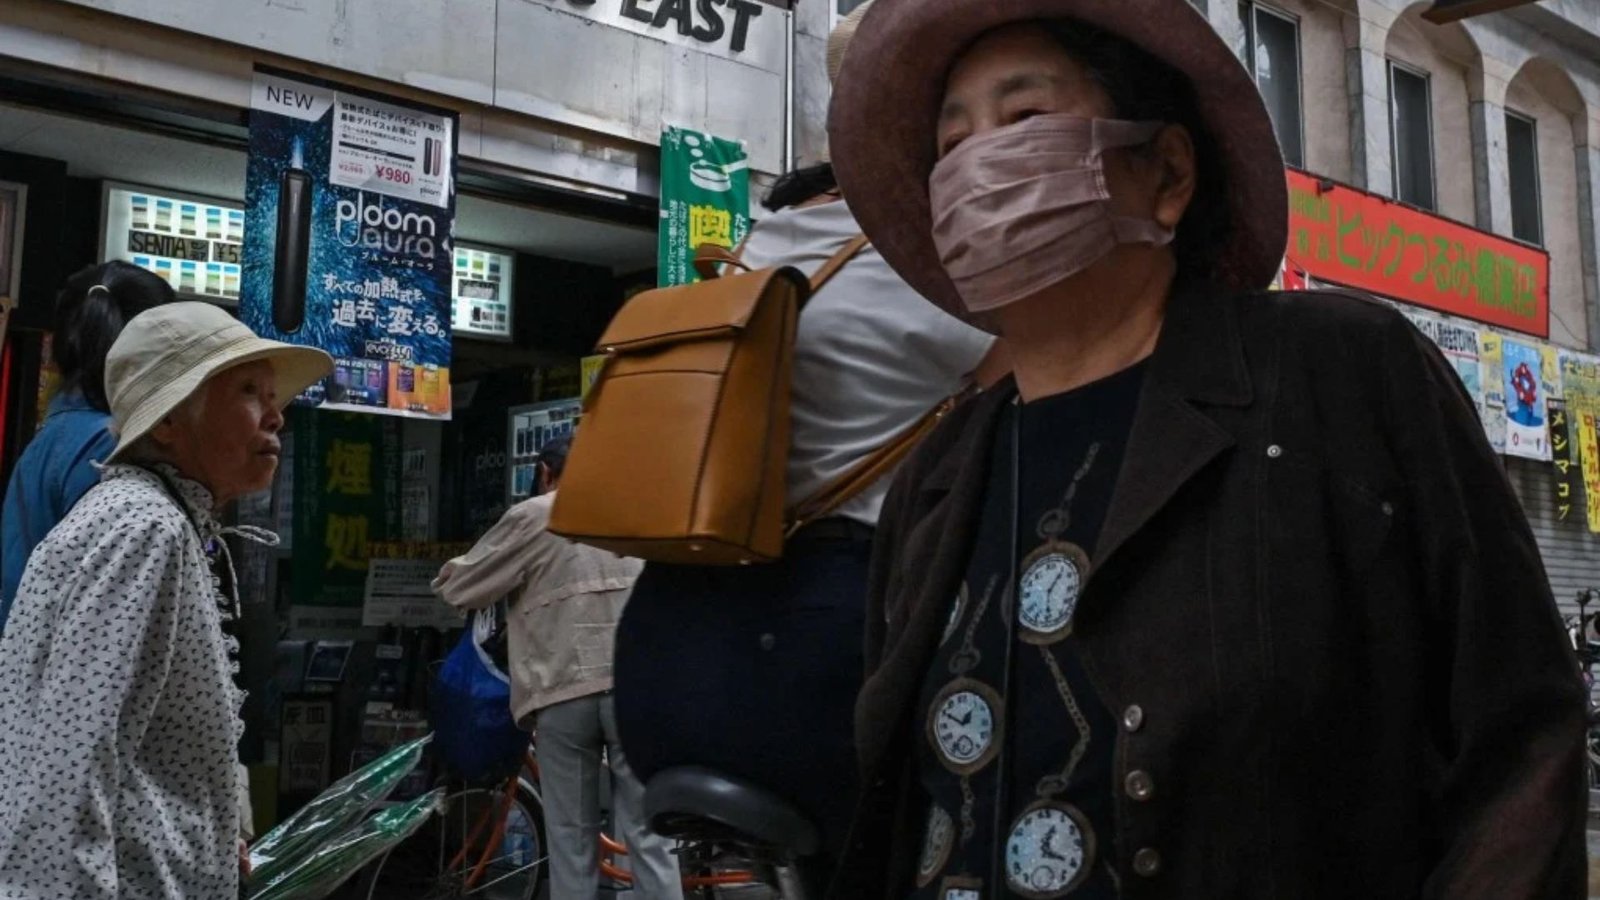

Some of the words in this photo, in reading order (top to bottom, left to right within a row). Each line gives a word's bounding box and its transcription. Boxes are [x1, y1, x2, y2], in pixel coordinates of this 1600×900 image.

[267, 85, 314, 110] NEW
[376, 165, 411, 185] ¥980
[336, 191, 436, 246] ploom
[131, 231, 187, 258] SENTIA
[362, 227, 435, 259] aura
[333, 299, 446, 338] 過去に変える。
